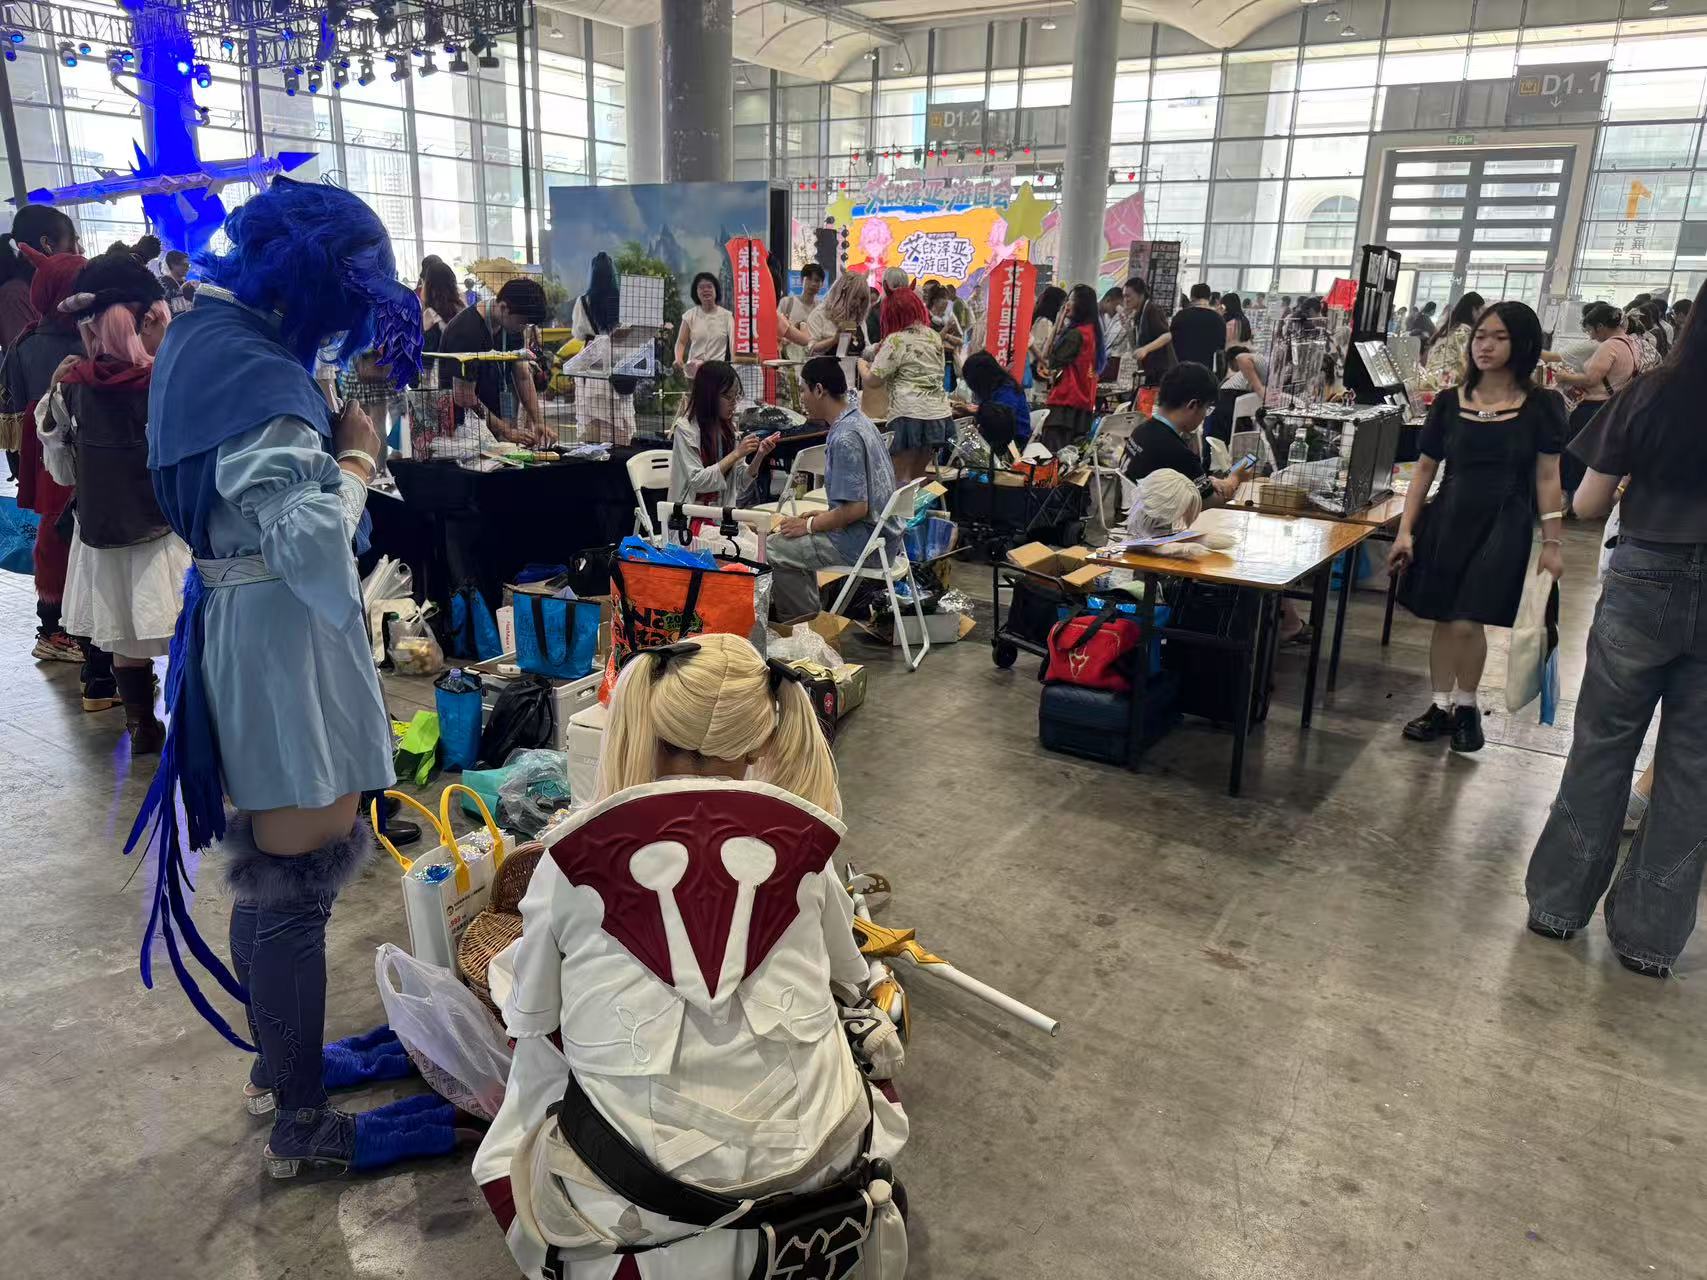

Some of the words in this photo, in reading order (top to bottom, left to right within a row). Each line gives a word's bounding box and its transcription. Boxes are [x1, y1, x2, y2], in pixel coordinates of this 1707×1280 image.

[1541, 71, 1601, 95] D1.1
[943, 109, 981, 128] D1.2
[917, 256, 965, 277] 游园会
